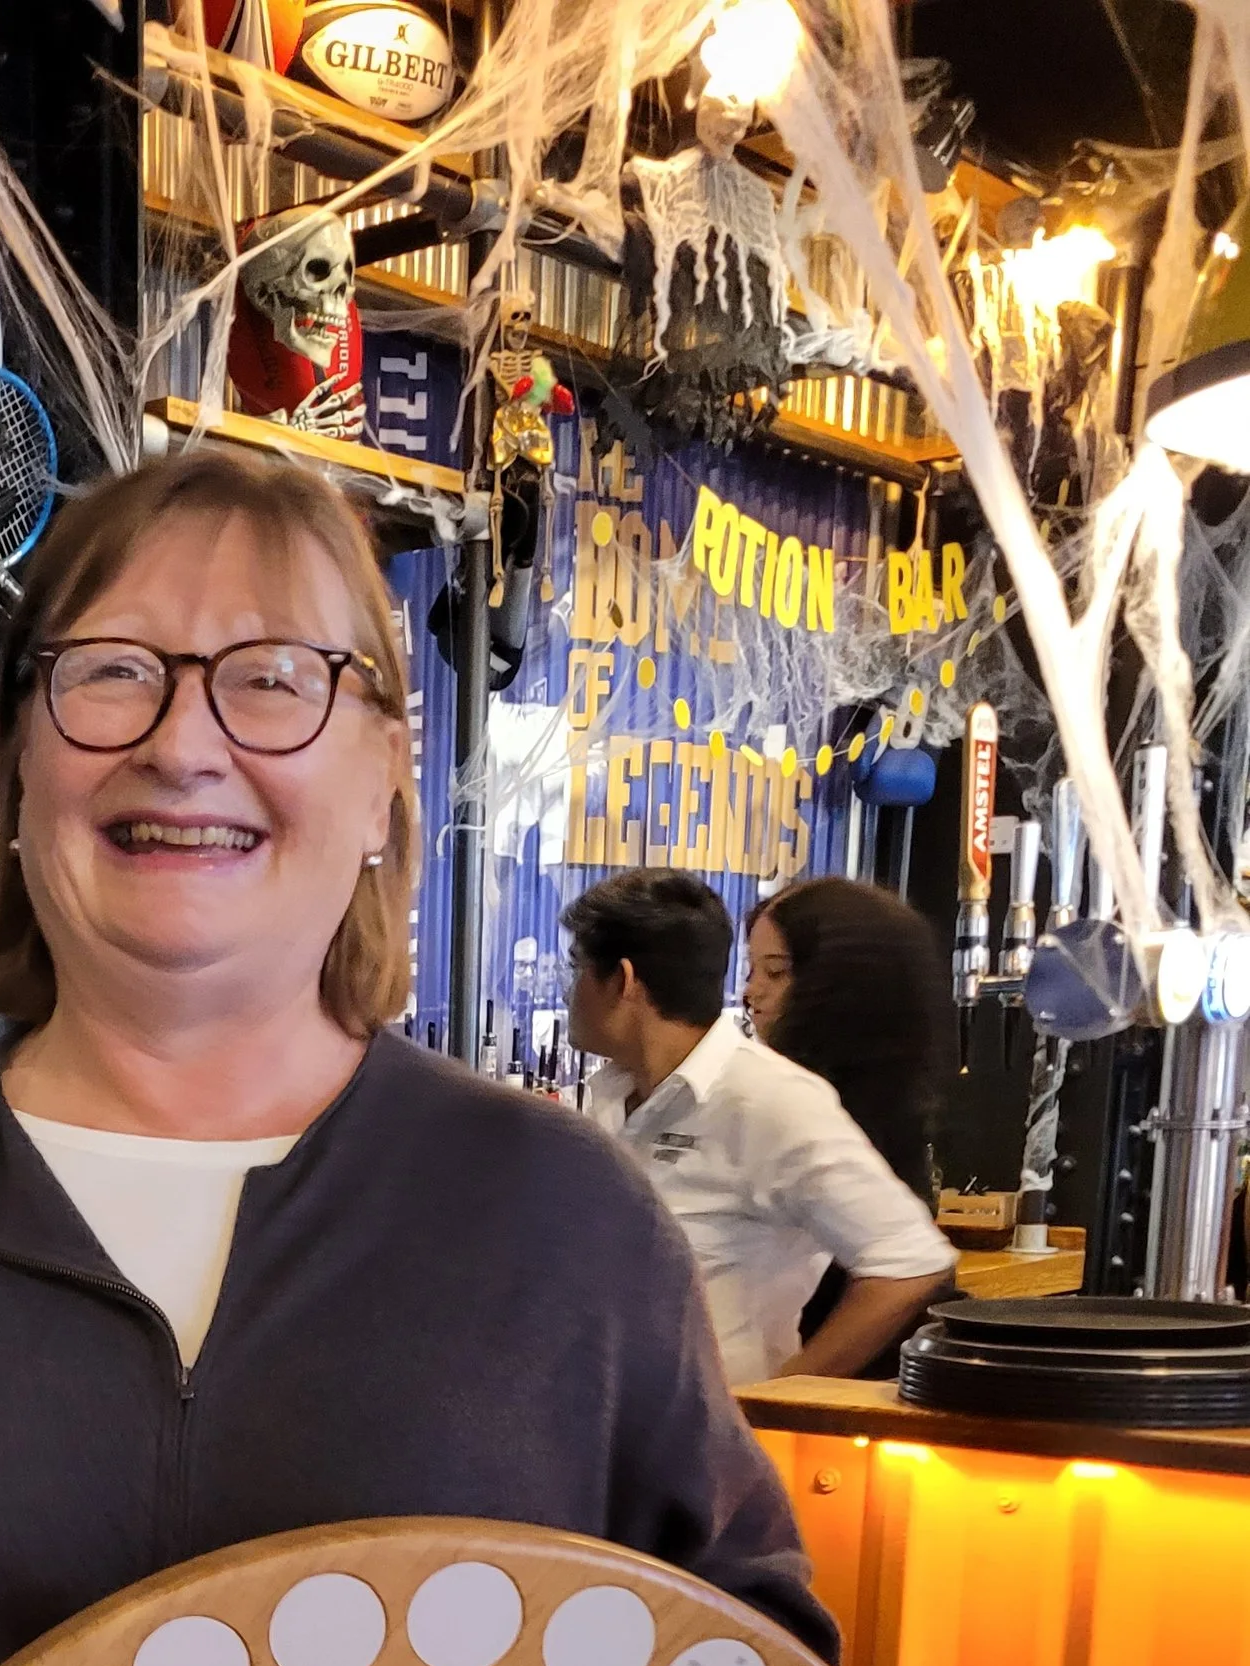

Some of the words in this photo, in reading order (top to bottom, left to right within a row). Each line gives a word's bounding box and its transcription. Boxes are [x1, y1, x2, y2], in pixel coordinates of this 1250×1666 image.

[325, 40, 448, 90] GILBERT
[694, 484, 835, 634] POTION
[888, 541, 969, 635] BAR
[566, 649, 615, 729] OF
[565, 730, 813, 880] LEGENDS
[973, 743, 992, 853] AMSTEL
